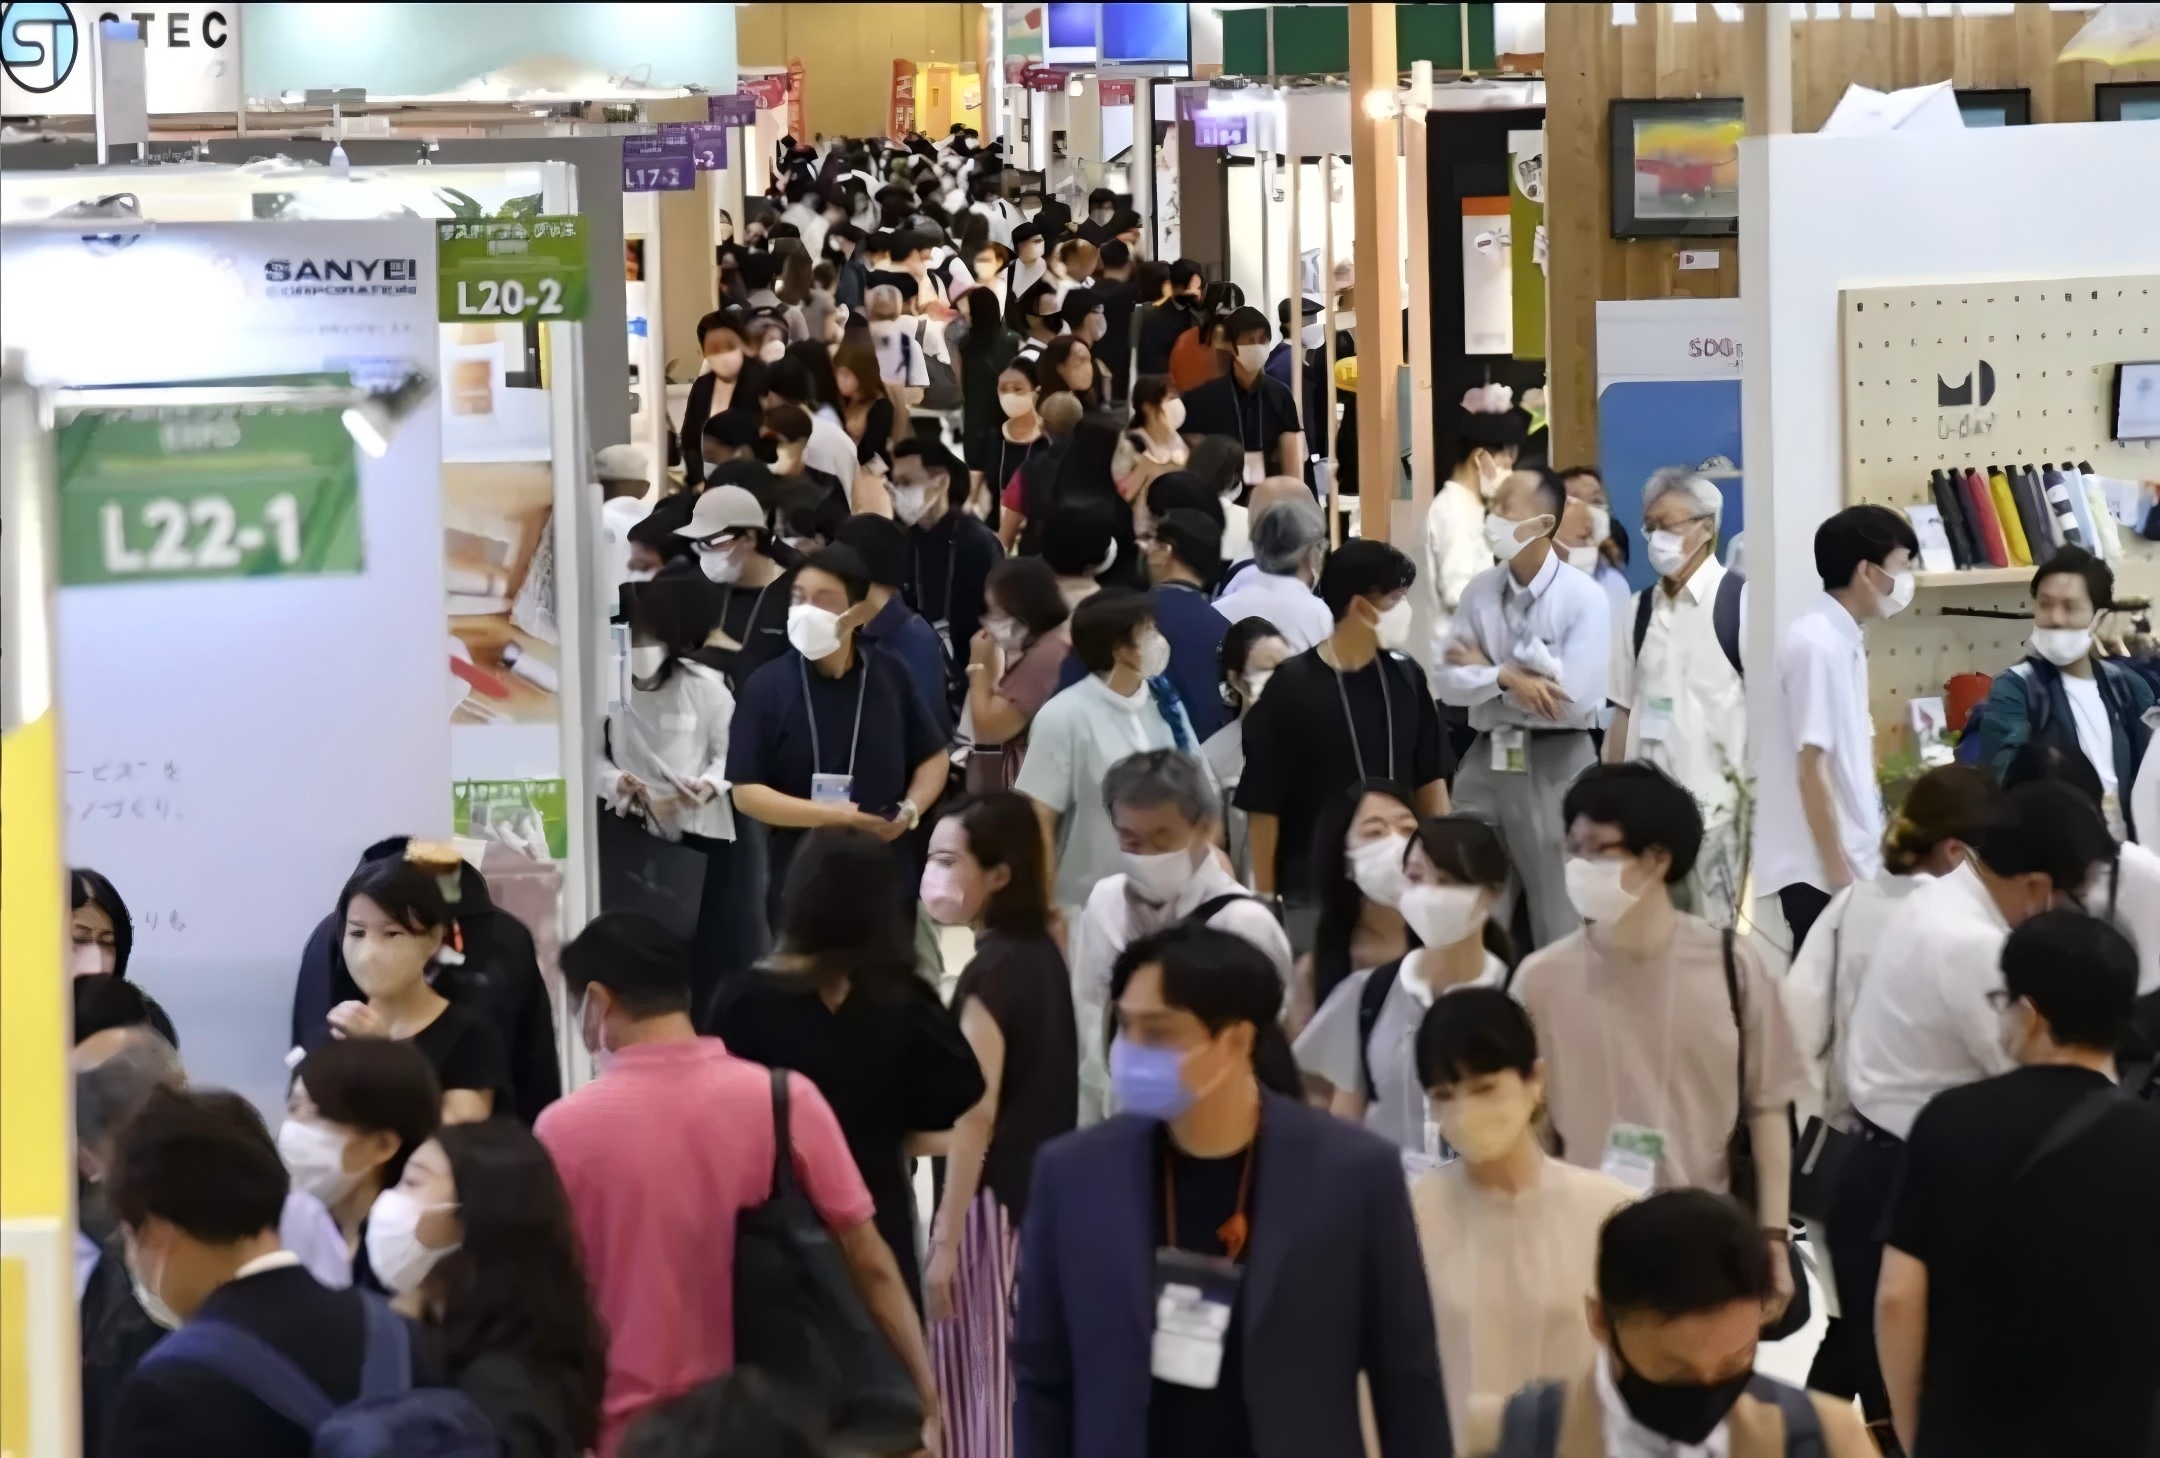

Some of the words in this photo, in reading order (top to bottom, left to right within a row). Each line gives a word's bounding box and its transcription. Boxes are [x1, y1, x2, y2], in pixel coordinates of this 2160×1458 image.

[99, 11, 228, 49] TEC
[265, 258, 416, 281] SANYEI
[457, 278, 564, 316] L20-2
[101, 492, 301, 573] L22-1
